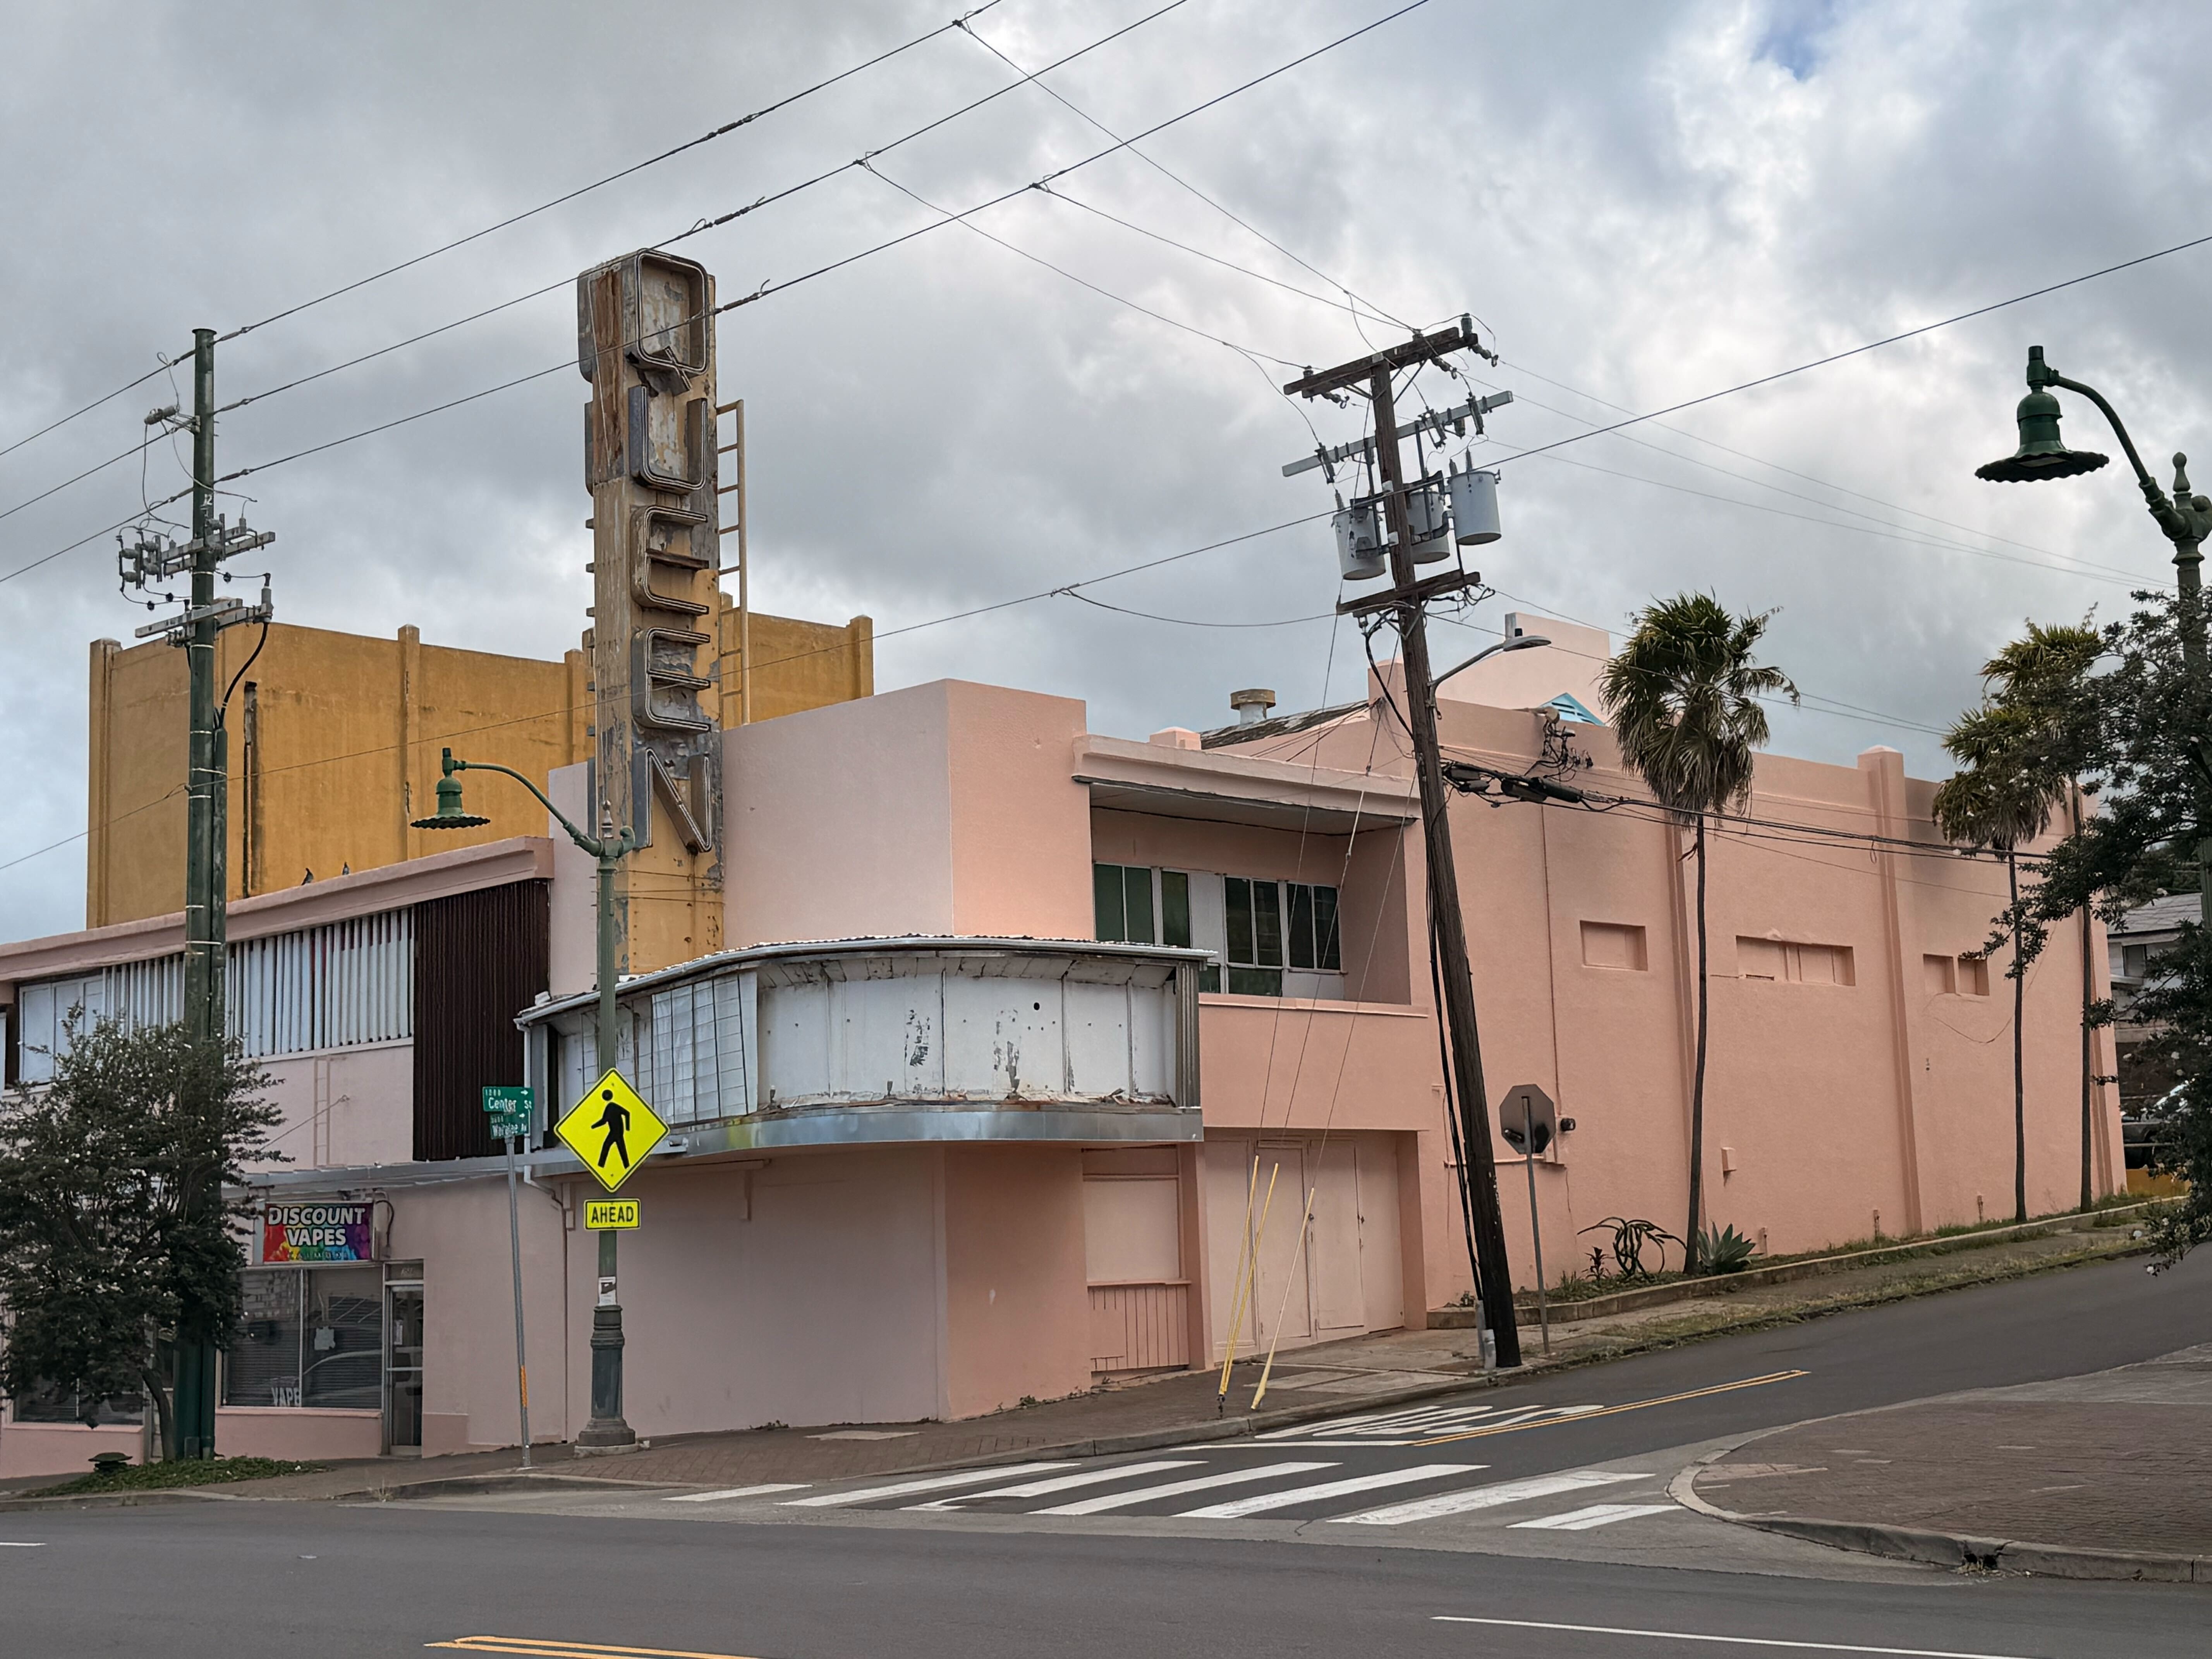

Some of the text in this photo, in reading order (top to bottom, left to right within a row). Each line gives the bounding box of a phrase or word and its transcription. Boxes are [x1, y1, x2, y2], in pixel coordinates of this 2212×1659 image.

[631, 248, 713, 852] QUEEN
[488, 1097, 517, 1110] Center
[268, 1206, 366, 1225] DISCOUNT
[591, 1206, 634, 1223] AHEAD
[287, 1228, 347, 1246] VAPES
